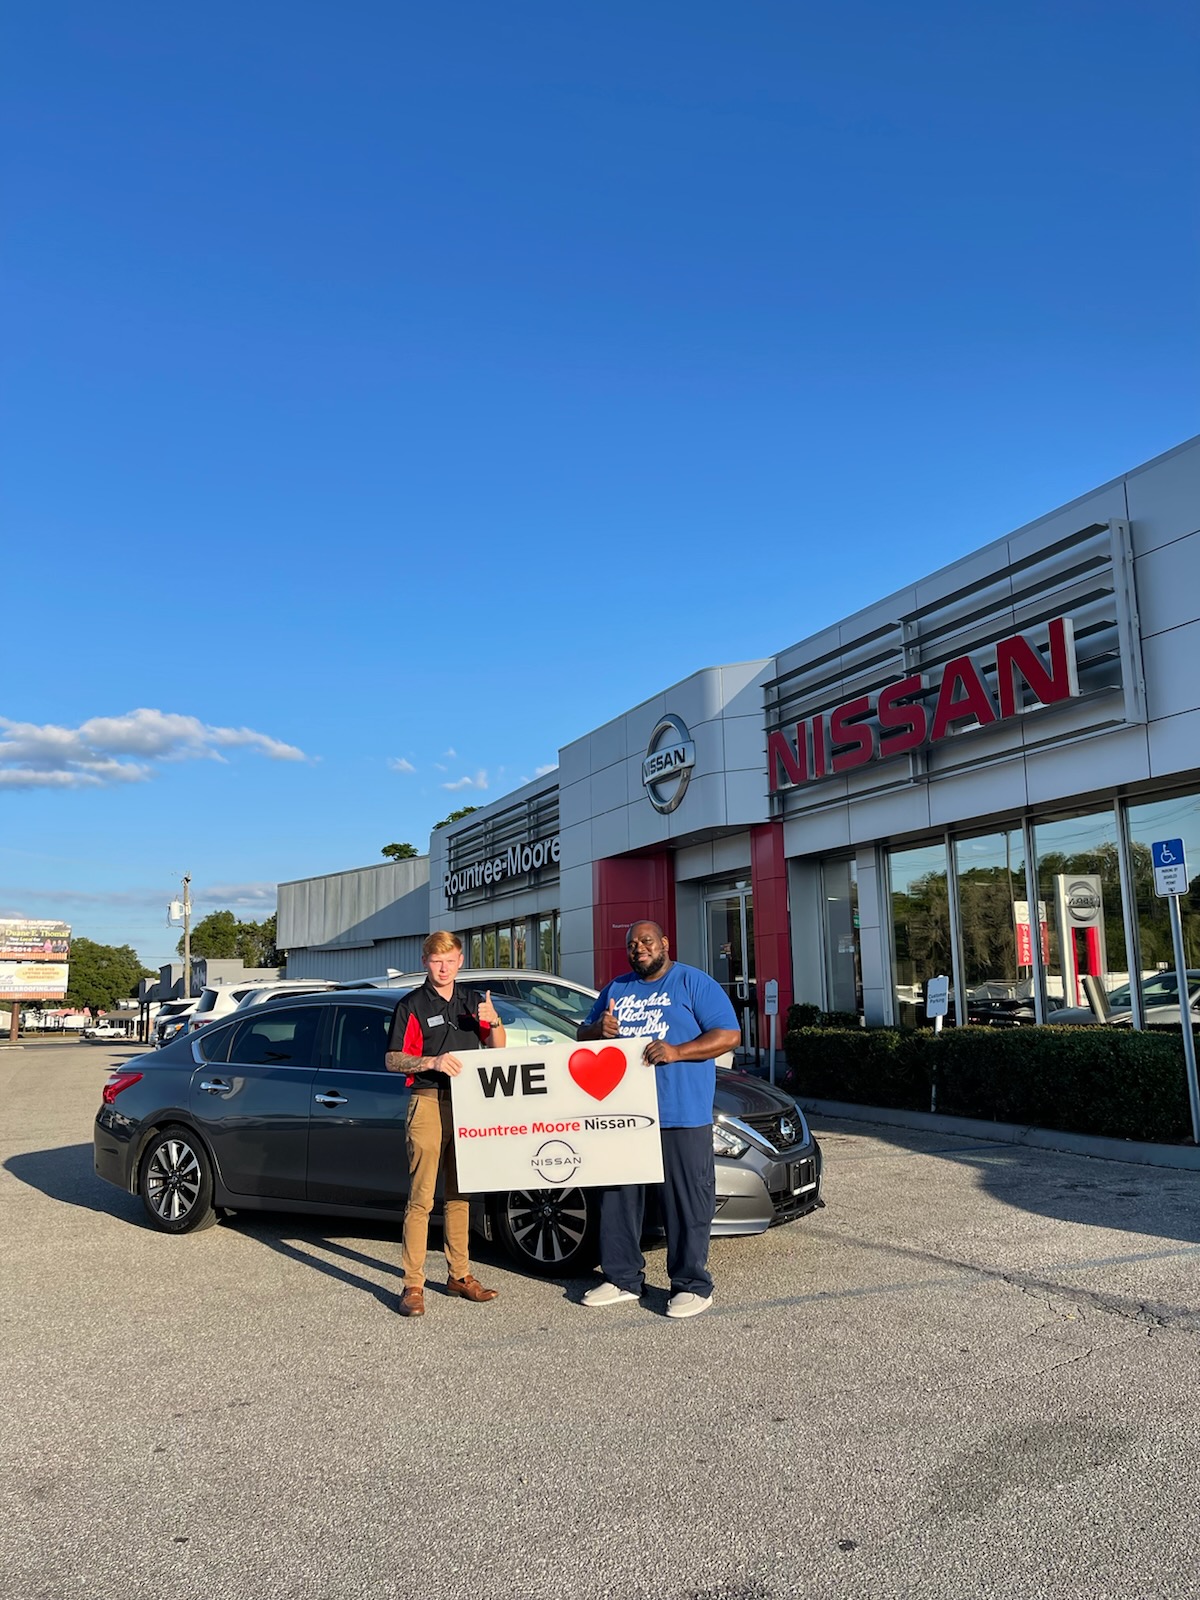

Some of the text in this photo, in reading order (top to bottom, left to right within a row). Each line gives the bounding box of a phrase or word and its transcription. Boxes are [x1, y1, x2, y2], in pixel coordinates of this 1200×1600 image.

[768, 617, 1074, 791] NISSAN
[644, 748, 685, 778] NISSAN
[444, 837, 560, 895] Rountree-Moore
[41, 930, 69, 938] Thomas
[614, 992, 671, 1010] Absolute
[618, 1007, 663, 1024] Victory
[477, 1063, 547, 1098] WE
[458, 1117, 636, 1139] Rountree Moore Nissan
[531, 1156, 582, 1167] NISSAN
